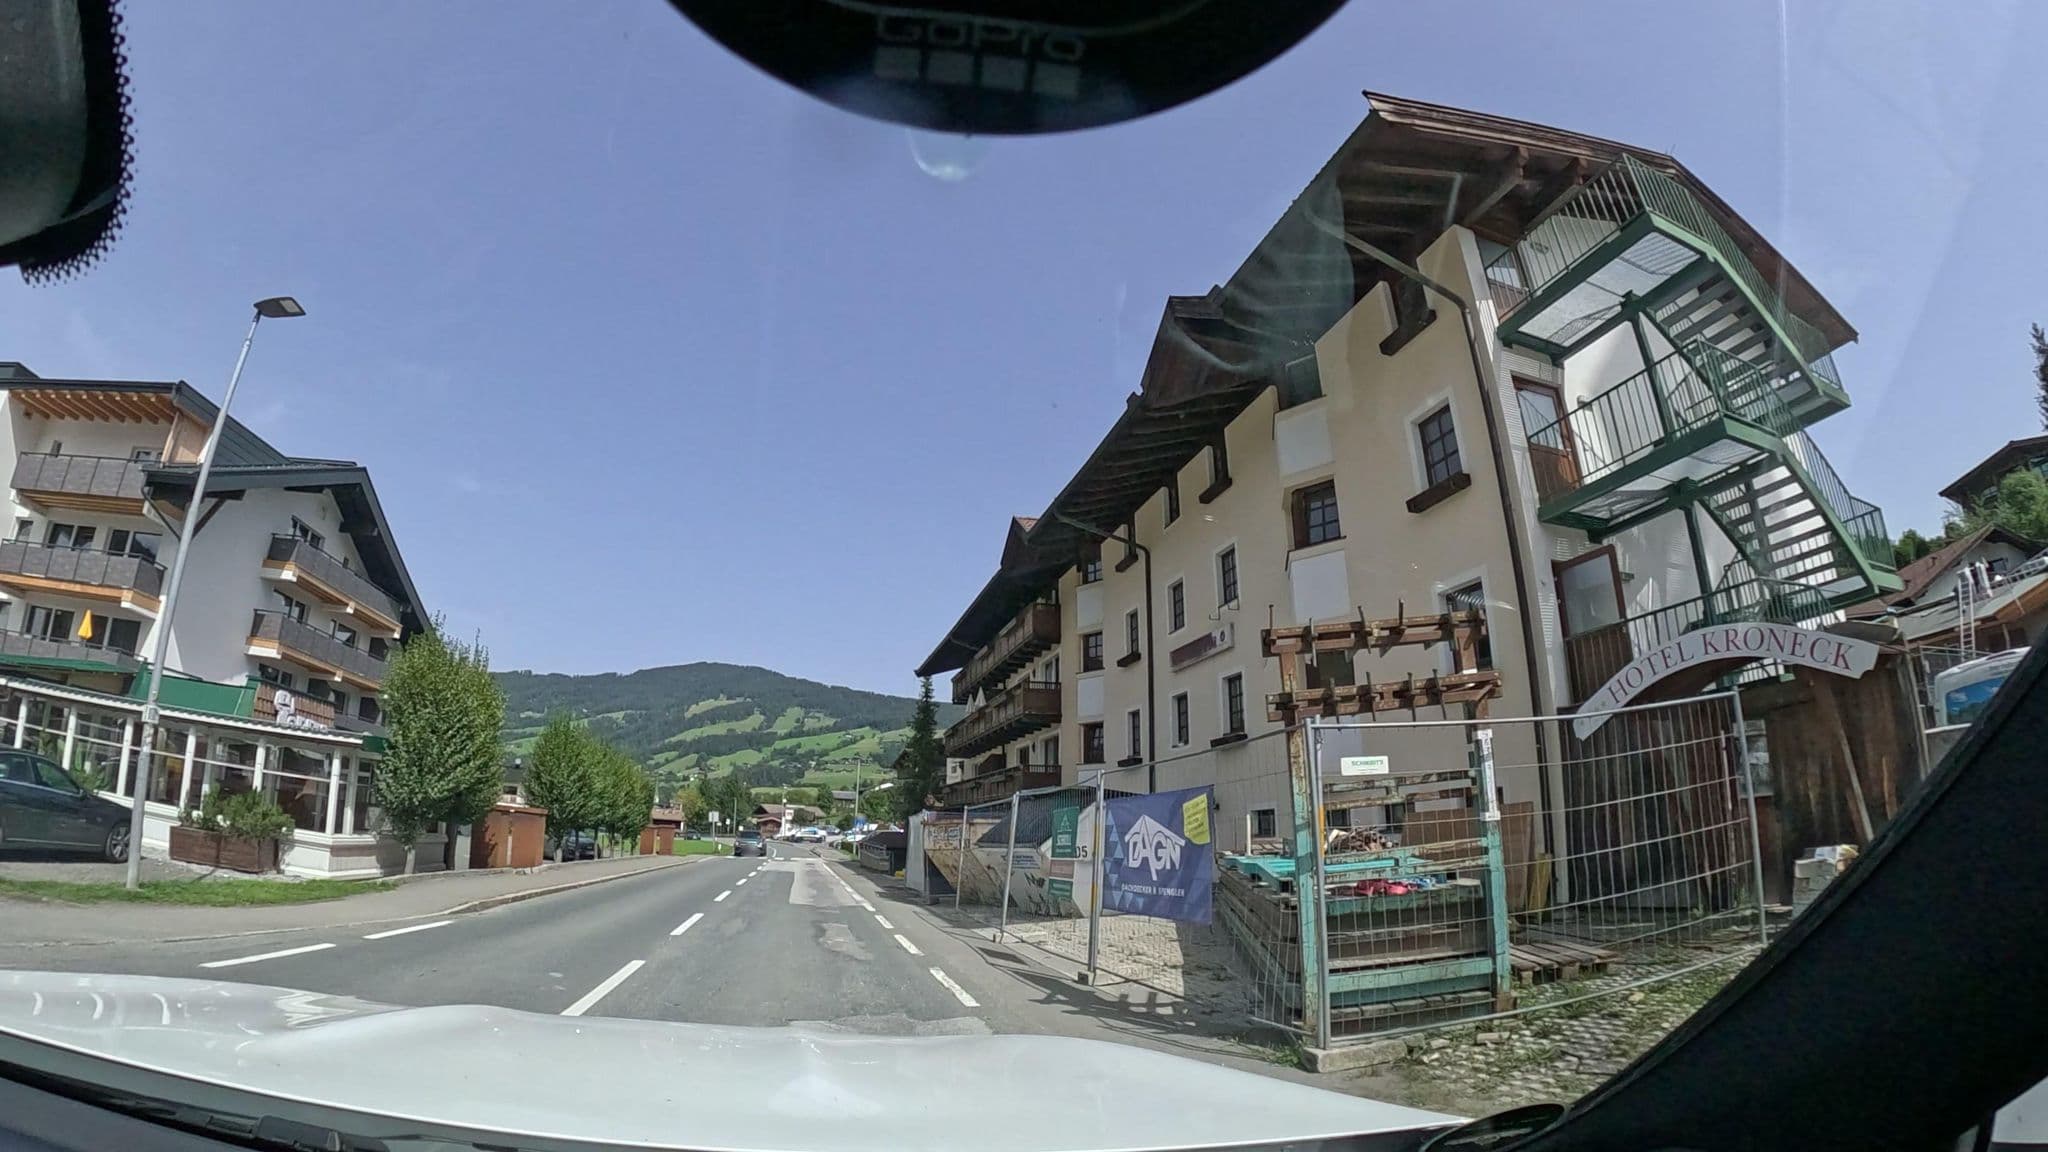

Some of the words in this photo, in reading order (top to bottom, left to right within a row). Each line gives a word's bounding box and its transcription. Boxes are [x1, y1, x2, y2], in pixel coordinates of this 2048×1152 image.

[1607, 640, 1695, 704] HOTEL
[1701, 626, 1855, 672] KRONECK
[1128, 815, 1182, 881] DAGN
